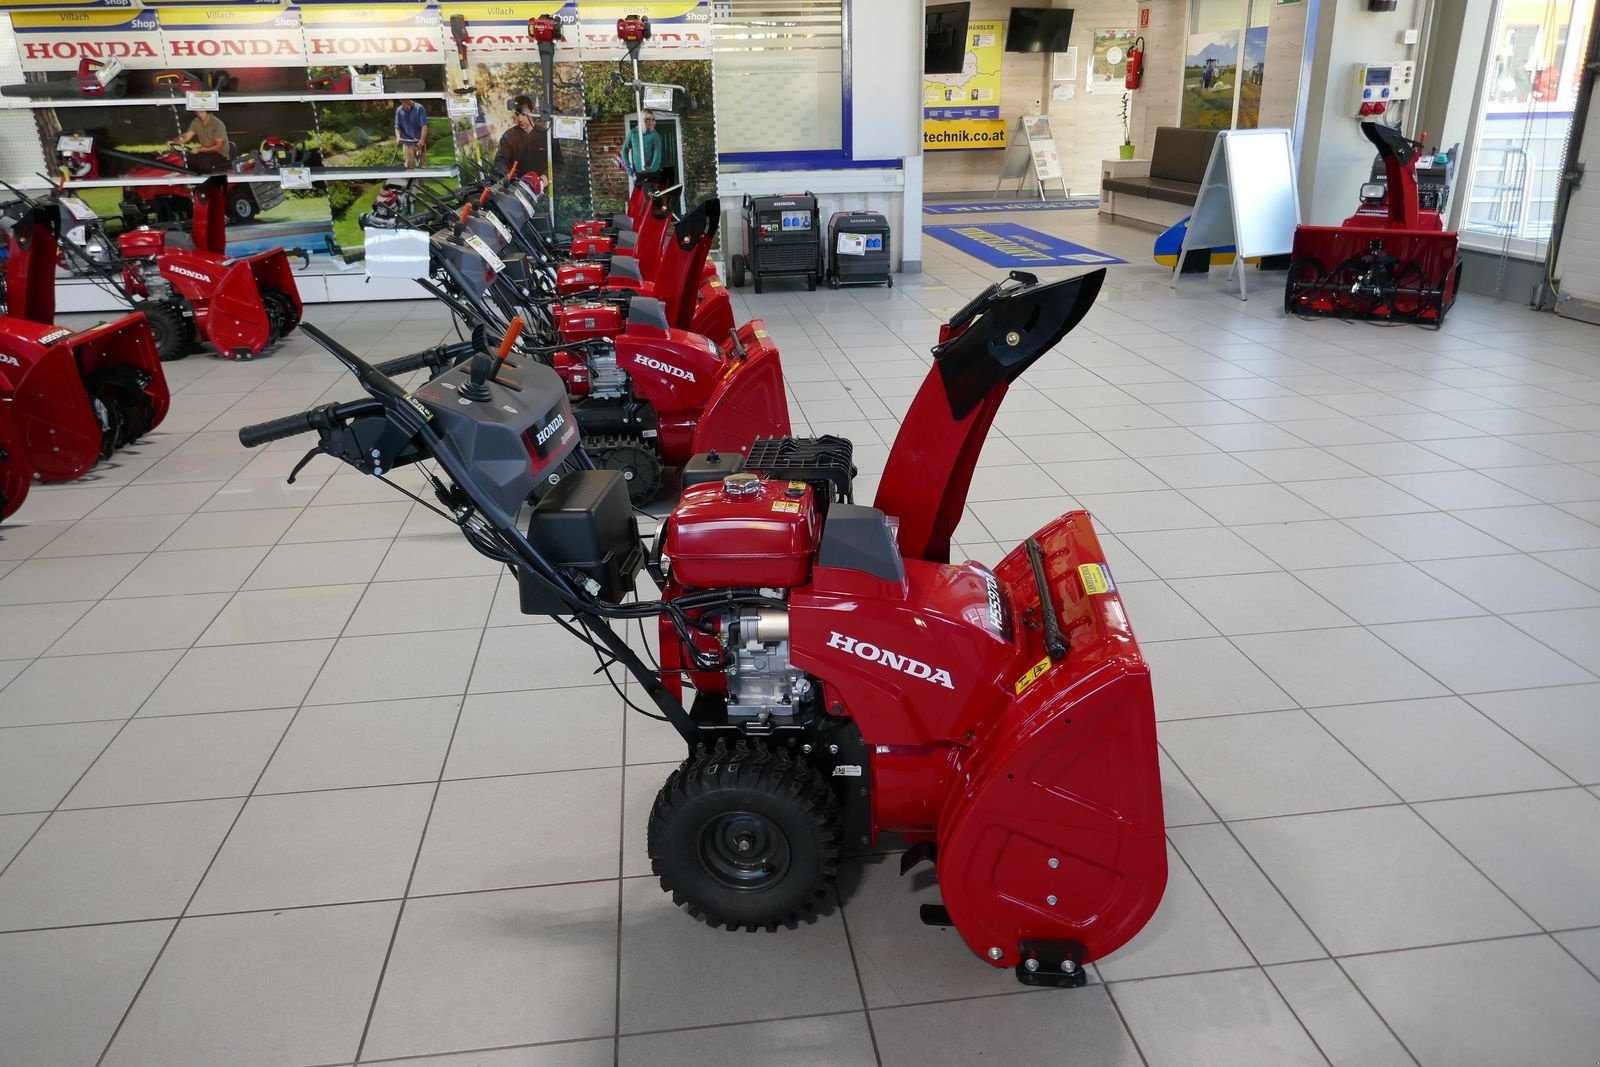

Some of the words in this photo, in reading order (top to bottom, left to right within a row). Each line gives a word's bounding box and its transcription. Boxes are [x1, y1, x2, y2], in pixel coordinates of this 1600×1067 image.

[60, 13, 90, 21] Villach
[205, 11, 235, 19] Villach
[275, 18, 299, 27] Shop
[415, 15, 438, 25] Shop
[685, 12, 708, 22] Shop
[131, 19, 156, 29] Shop
[24, 41, 158, 59] HONDA
[169, 39, 299, 57] HONDA
[311, 37, 438, 54] HONDA
[169, 264, 212, 283] HONDA
[633, 353, 697, 383] HONDA
[536, 414, 565, 446] HONDA
[826, 631, 955, 690] HONDA
